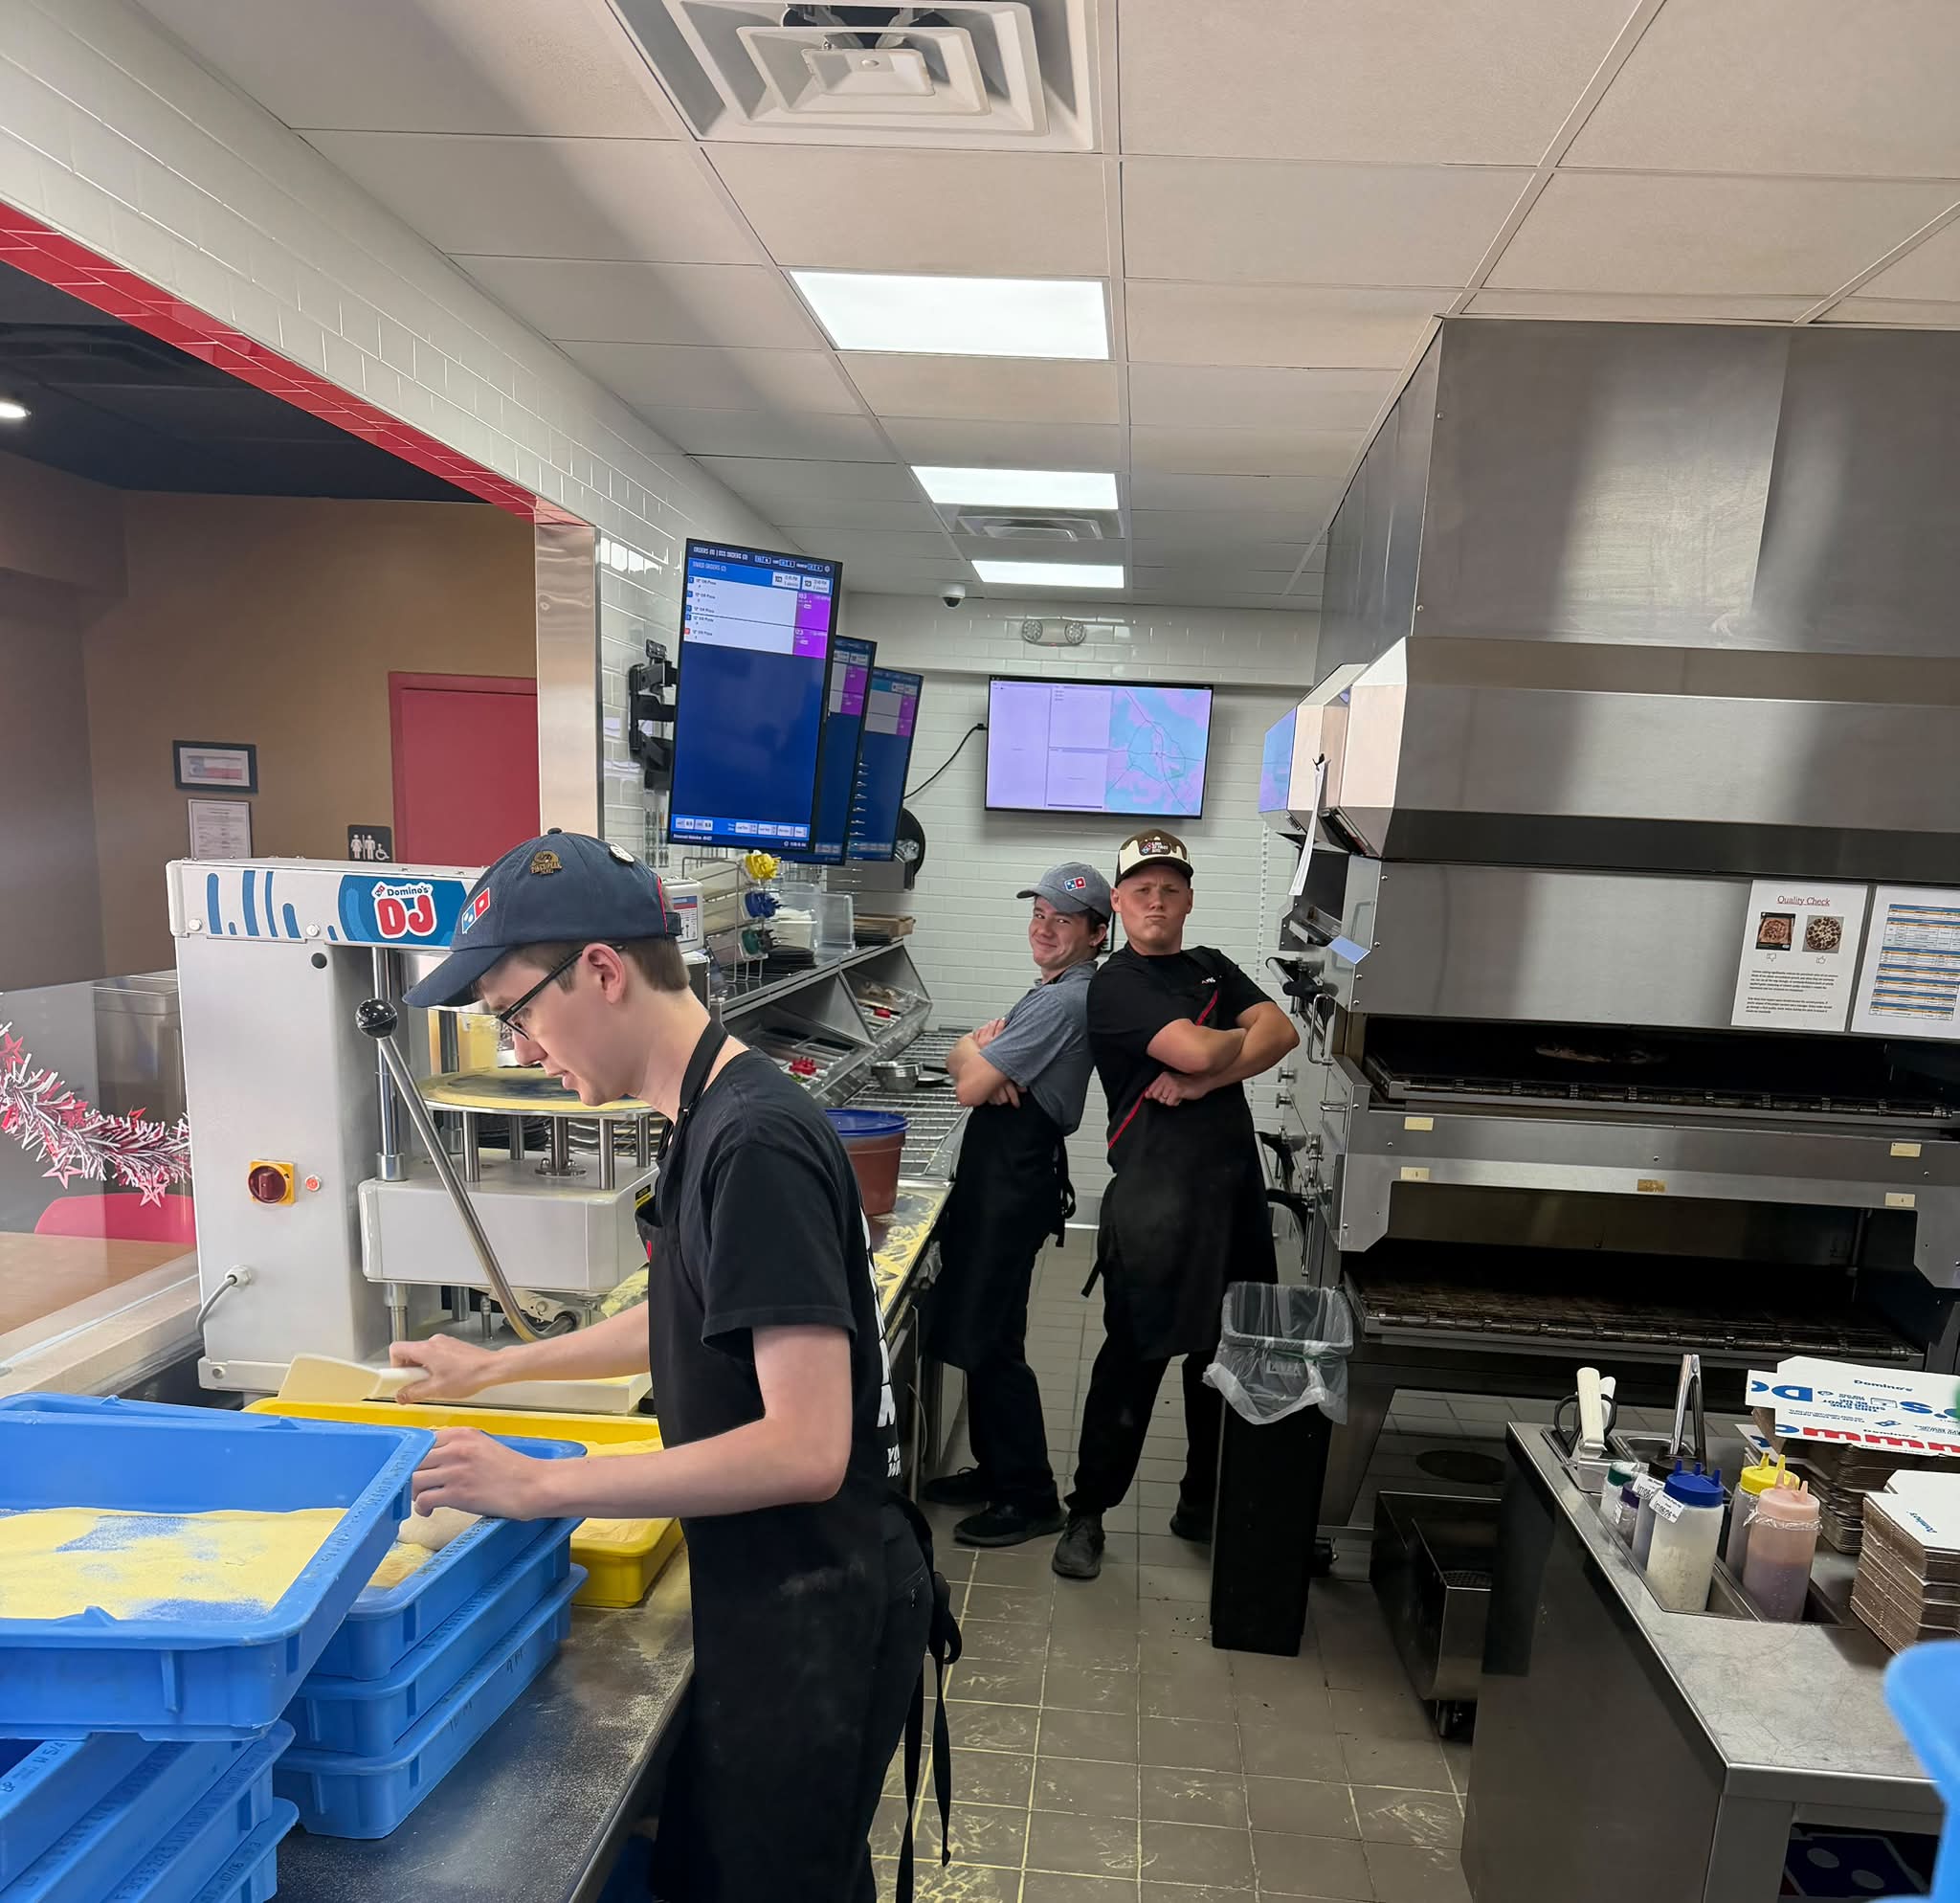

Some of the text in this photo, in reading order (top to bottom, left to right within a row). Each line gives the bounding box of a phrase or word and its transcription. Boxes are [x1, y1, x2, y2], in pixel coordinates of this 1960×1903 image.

[387, 885, 429, 896] Domino's
[1777, 895, 1830, 907] Quality Check
[377, 895, 434, 935] DJ
[1853, 1379, 1913, 1392] Domino's
